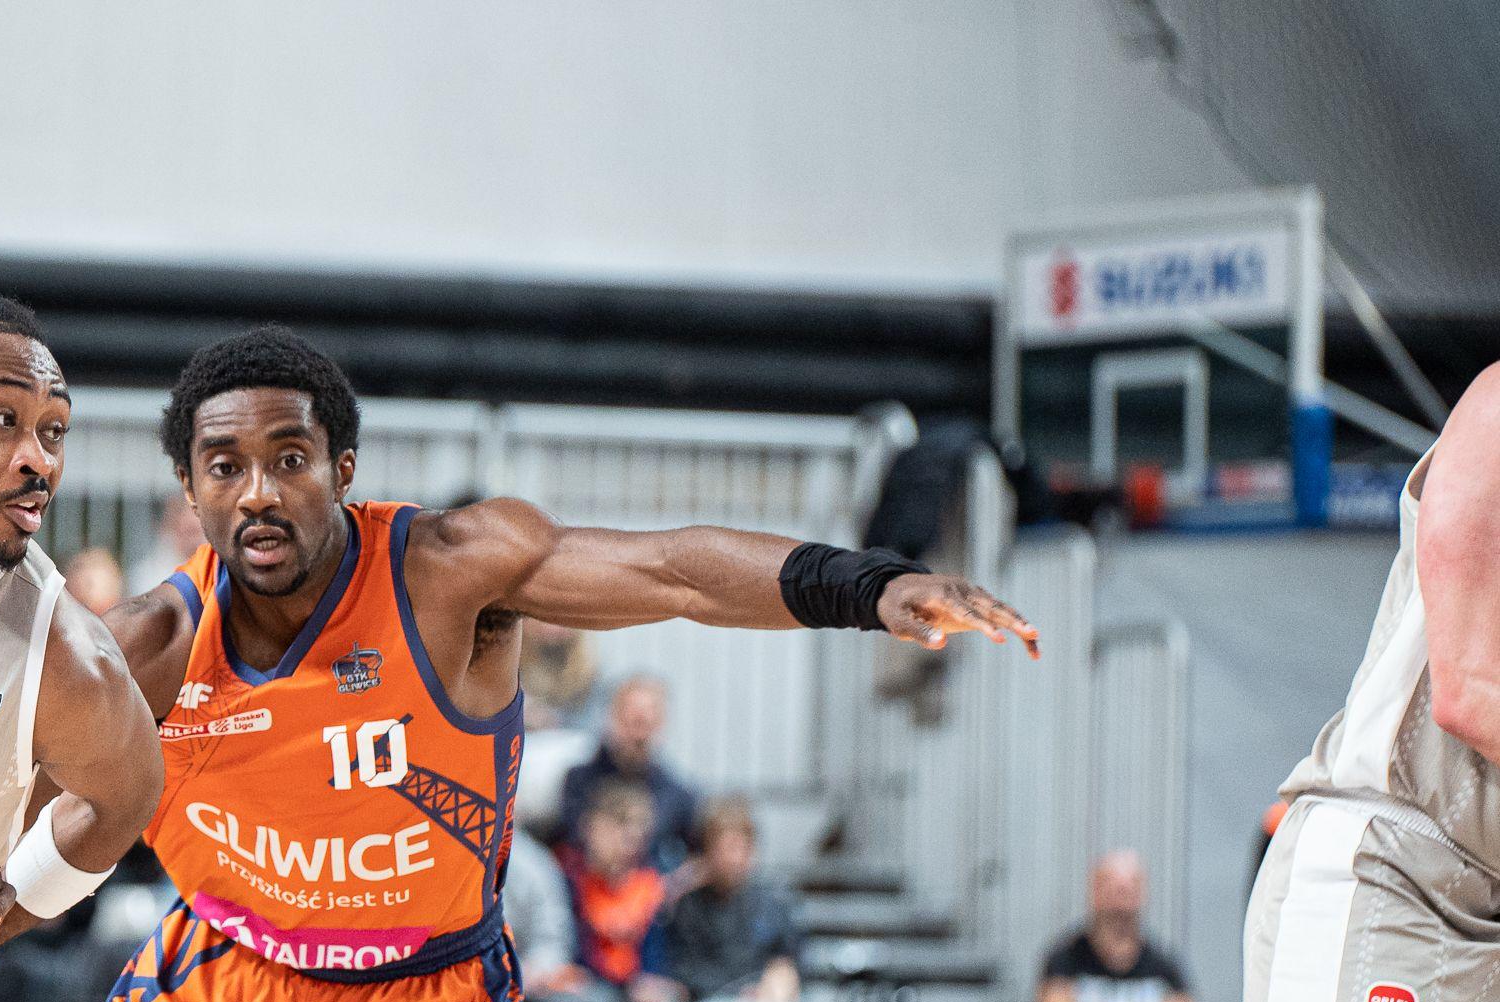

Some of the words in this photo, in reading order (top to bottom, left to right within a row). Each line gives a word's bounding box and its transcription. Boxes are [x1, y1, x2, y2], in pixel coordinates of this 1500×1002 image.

[234, 712, 265, 723] Basket
[234, 722, 254, 731] Liga
[323, 719, 408, 790] 10
[186, 802, 435, 882] GLIWICE
[326, 891, 377, 910] jest
[383, 888, 410, 906] tu
[261, 934, 412, 970] TAURON
